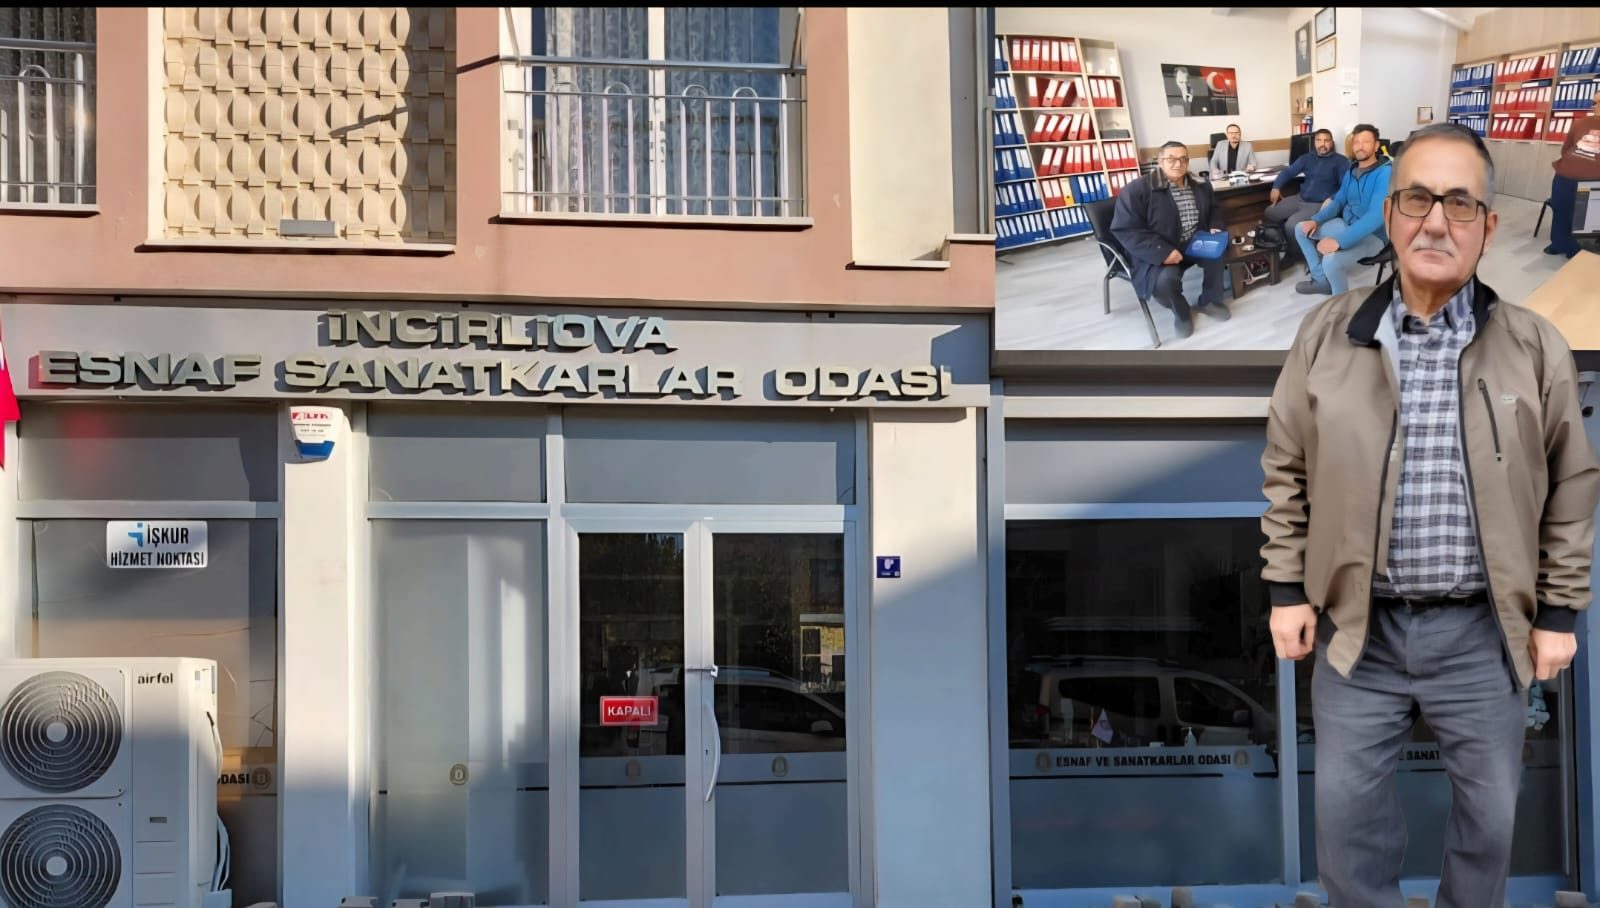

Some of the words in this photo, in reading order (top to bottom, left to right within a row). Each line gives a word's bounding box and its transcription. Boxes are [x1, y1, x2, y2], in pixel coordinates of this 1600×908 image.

[38, 351, 262, 386] ESNAF
[284, 354, 742, 396] SANATKARLAR
[775, 366, 951, 397] ODASI
[147, 524, 189, 548] İŞKUR
[110, 550, 152, 566] HİZMET
[157, 552, 204, 566] NOKTASI
[607, 705, 651, 717] KAPALI
[1056, 757, 1091, 768] ESNAF
[1096, 756, 1110, 767] VE
[1113, 755, 1195, 768] SANATKARLAR
[1198, 754, 1231, 765] ODASI
